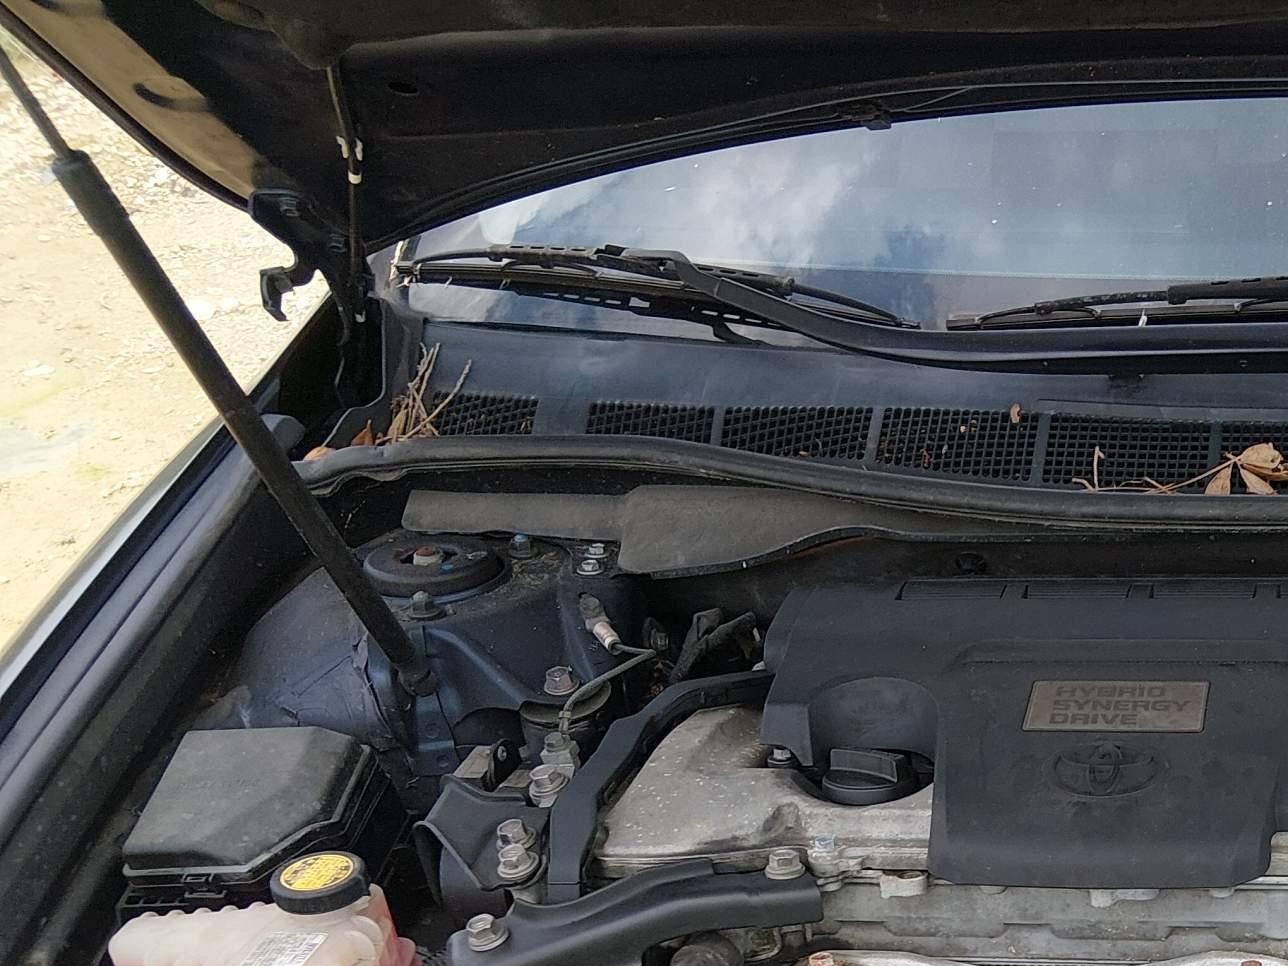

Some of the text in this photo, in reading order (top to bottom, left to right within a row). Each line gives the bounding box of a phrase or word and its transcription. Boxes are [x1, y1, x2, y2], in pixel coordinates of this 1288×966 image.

[1055, 686, 1167, 698] HYBRID
[1052, 700, 1191, 712] SYNERGY
[1049, 713, 1138, 725] DRIVE
